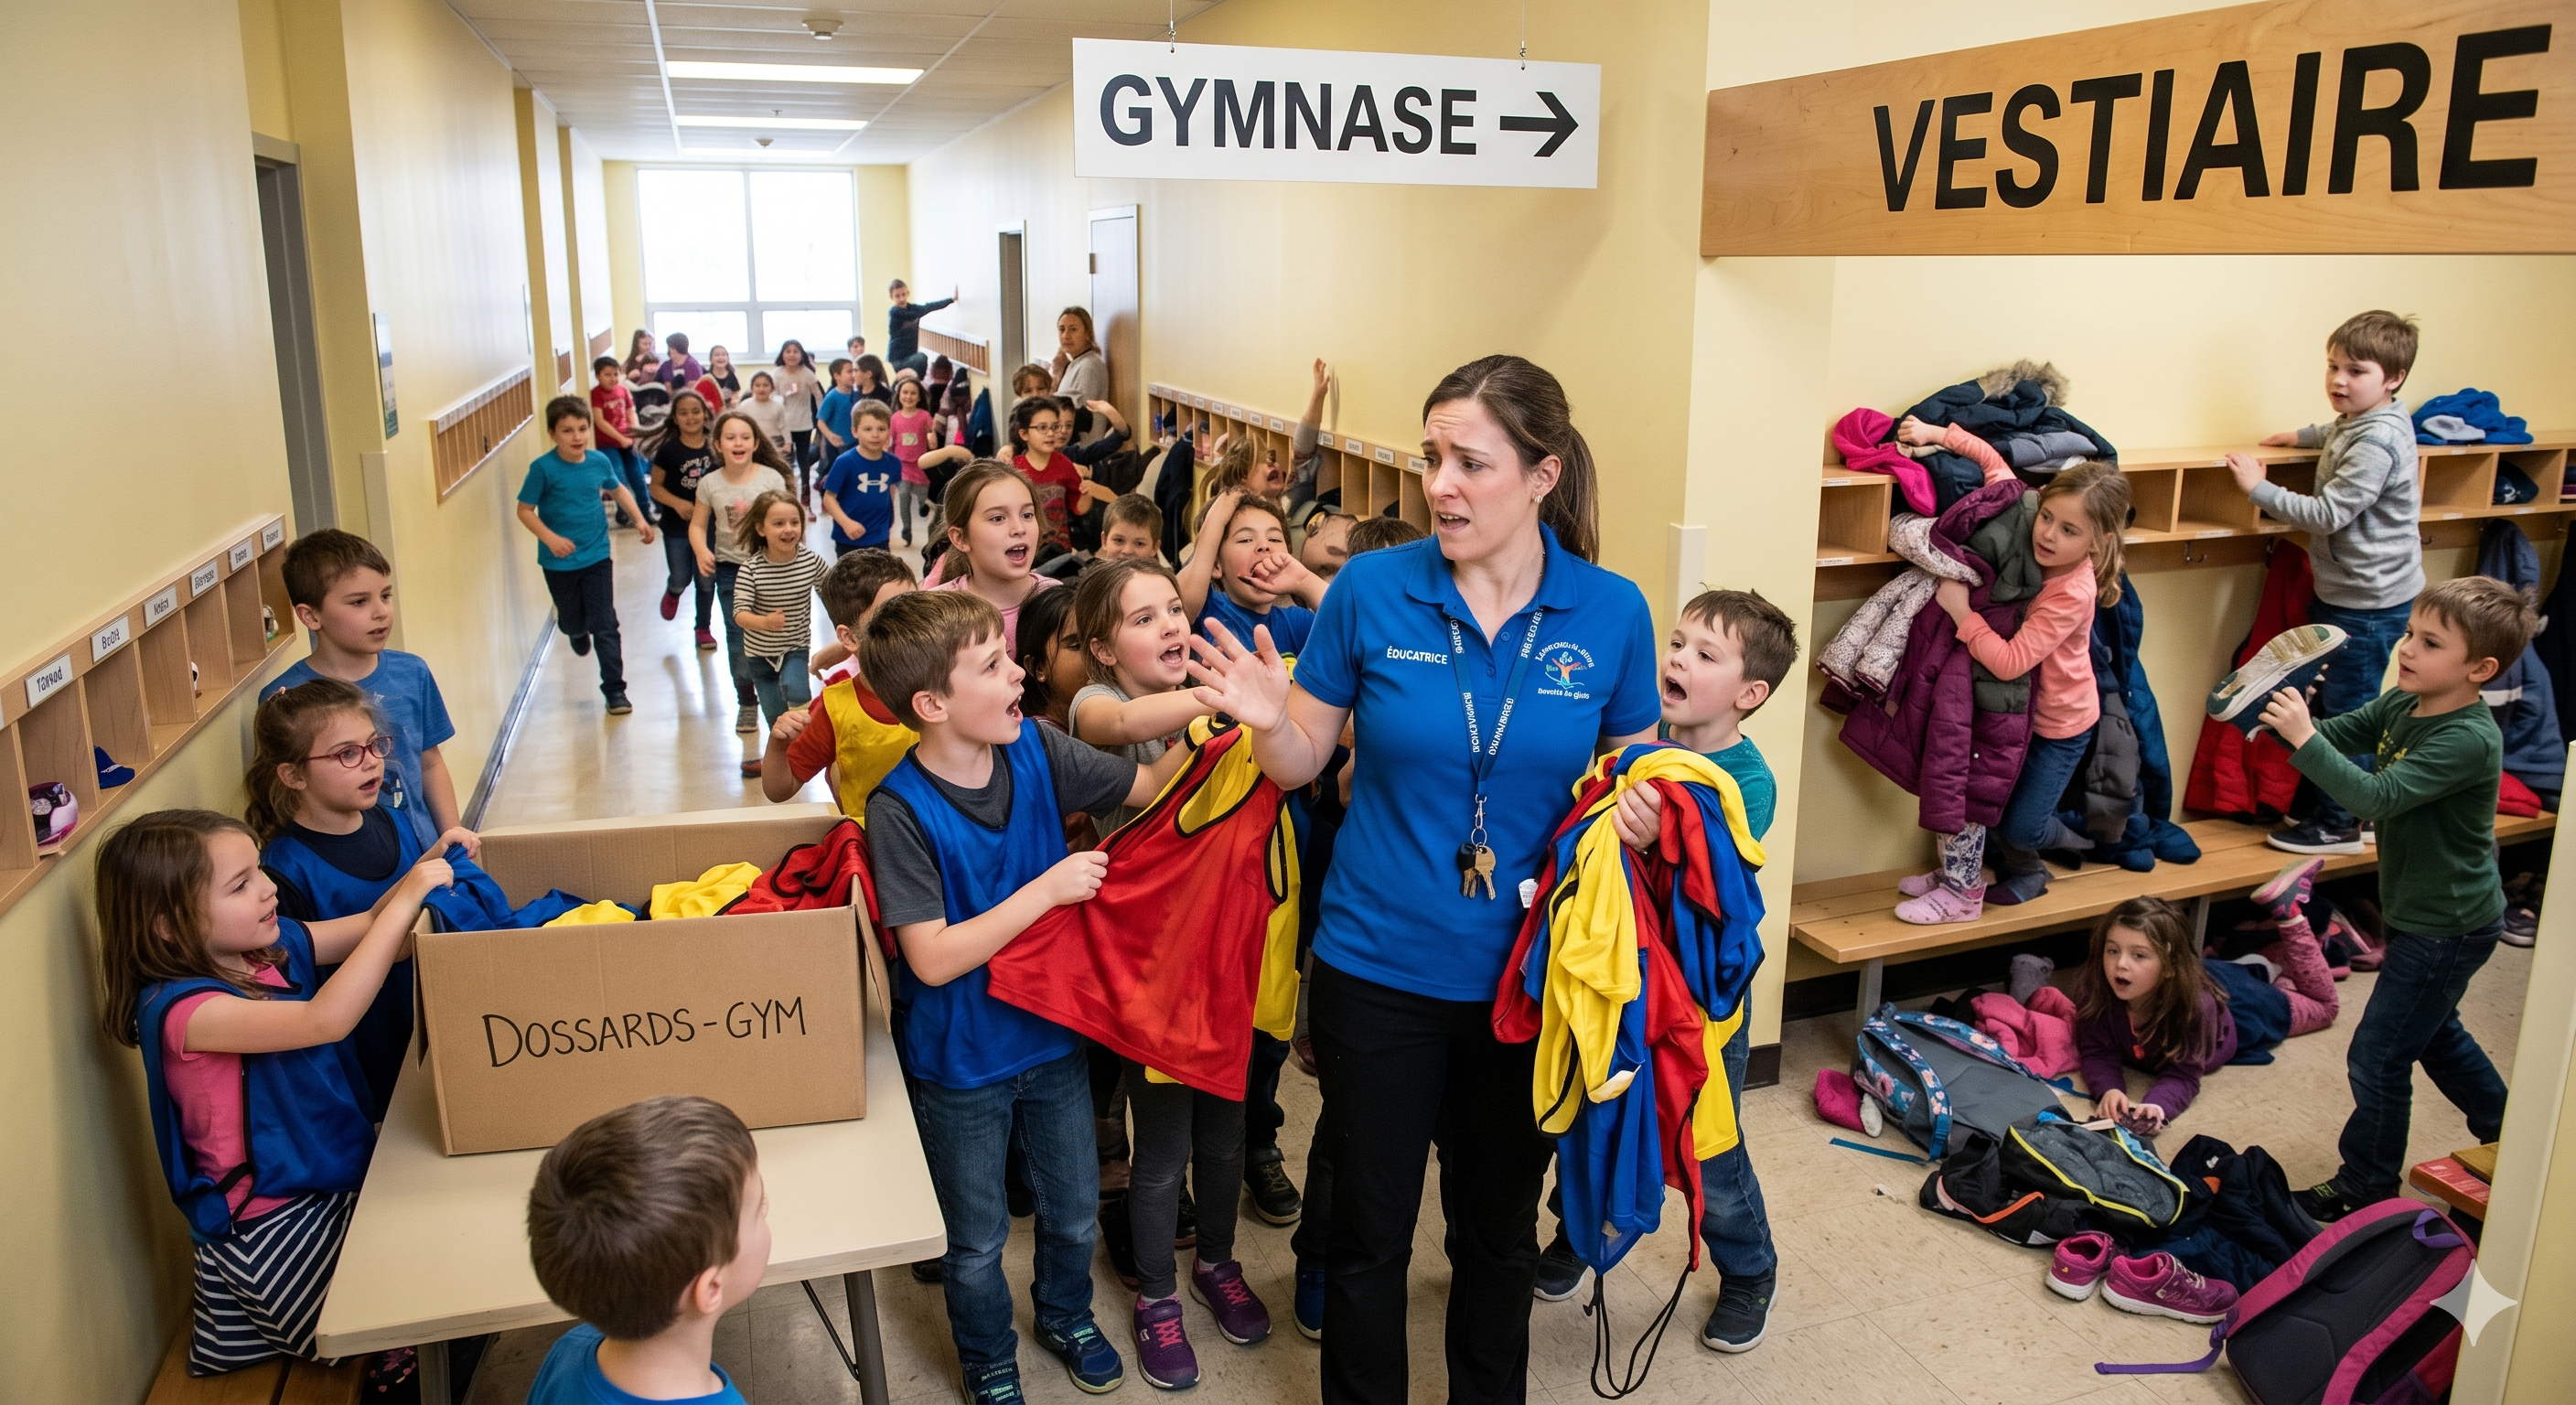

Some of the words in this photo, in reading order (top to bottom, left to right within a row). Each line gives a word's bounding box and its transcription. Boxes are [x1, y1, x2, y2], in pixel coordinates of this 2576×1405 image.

[1100, 73, 1477, 156] GYMNASE
[1873, 24, 2552, 212] VESTIAIRE
[1386, 645, 1448, 665] ÉDUCATRICE
[481, 1008, 695, 1067] DOSSARDS
[725, 996, 807, 1040] GYM
